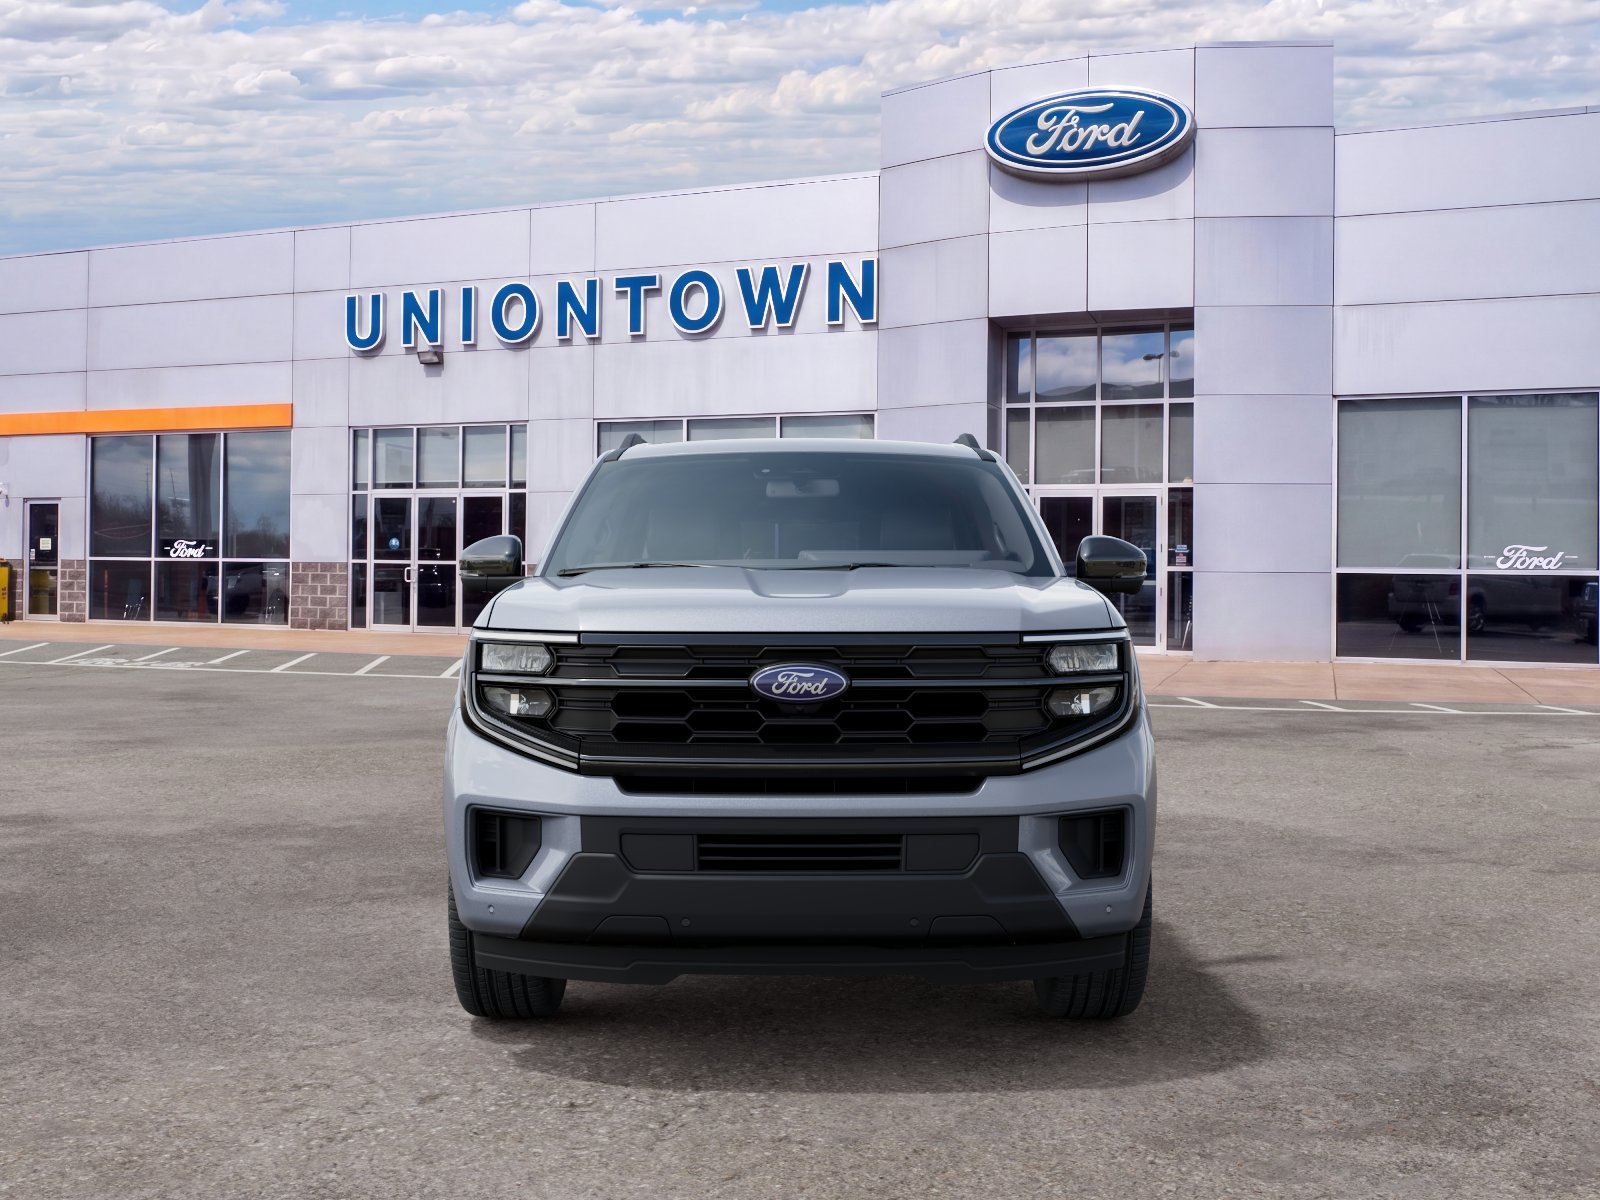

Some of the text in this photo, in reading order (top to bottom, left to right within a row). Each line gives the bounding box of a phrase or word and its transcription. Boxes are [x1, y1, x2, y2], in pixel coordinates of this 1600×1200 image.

[1026, 102, 1145, 155] Ford
[345, 257, 879, 352] UNIONTOWN
[170, 539, 205, 558] Ford
[1495, 544, 1564, 569] Ford
[771, 671, 828, 694] Ford
